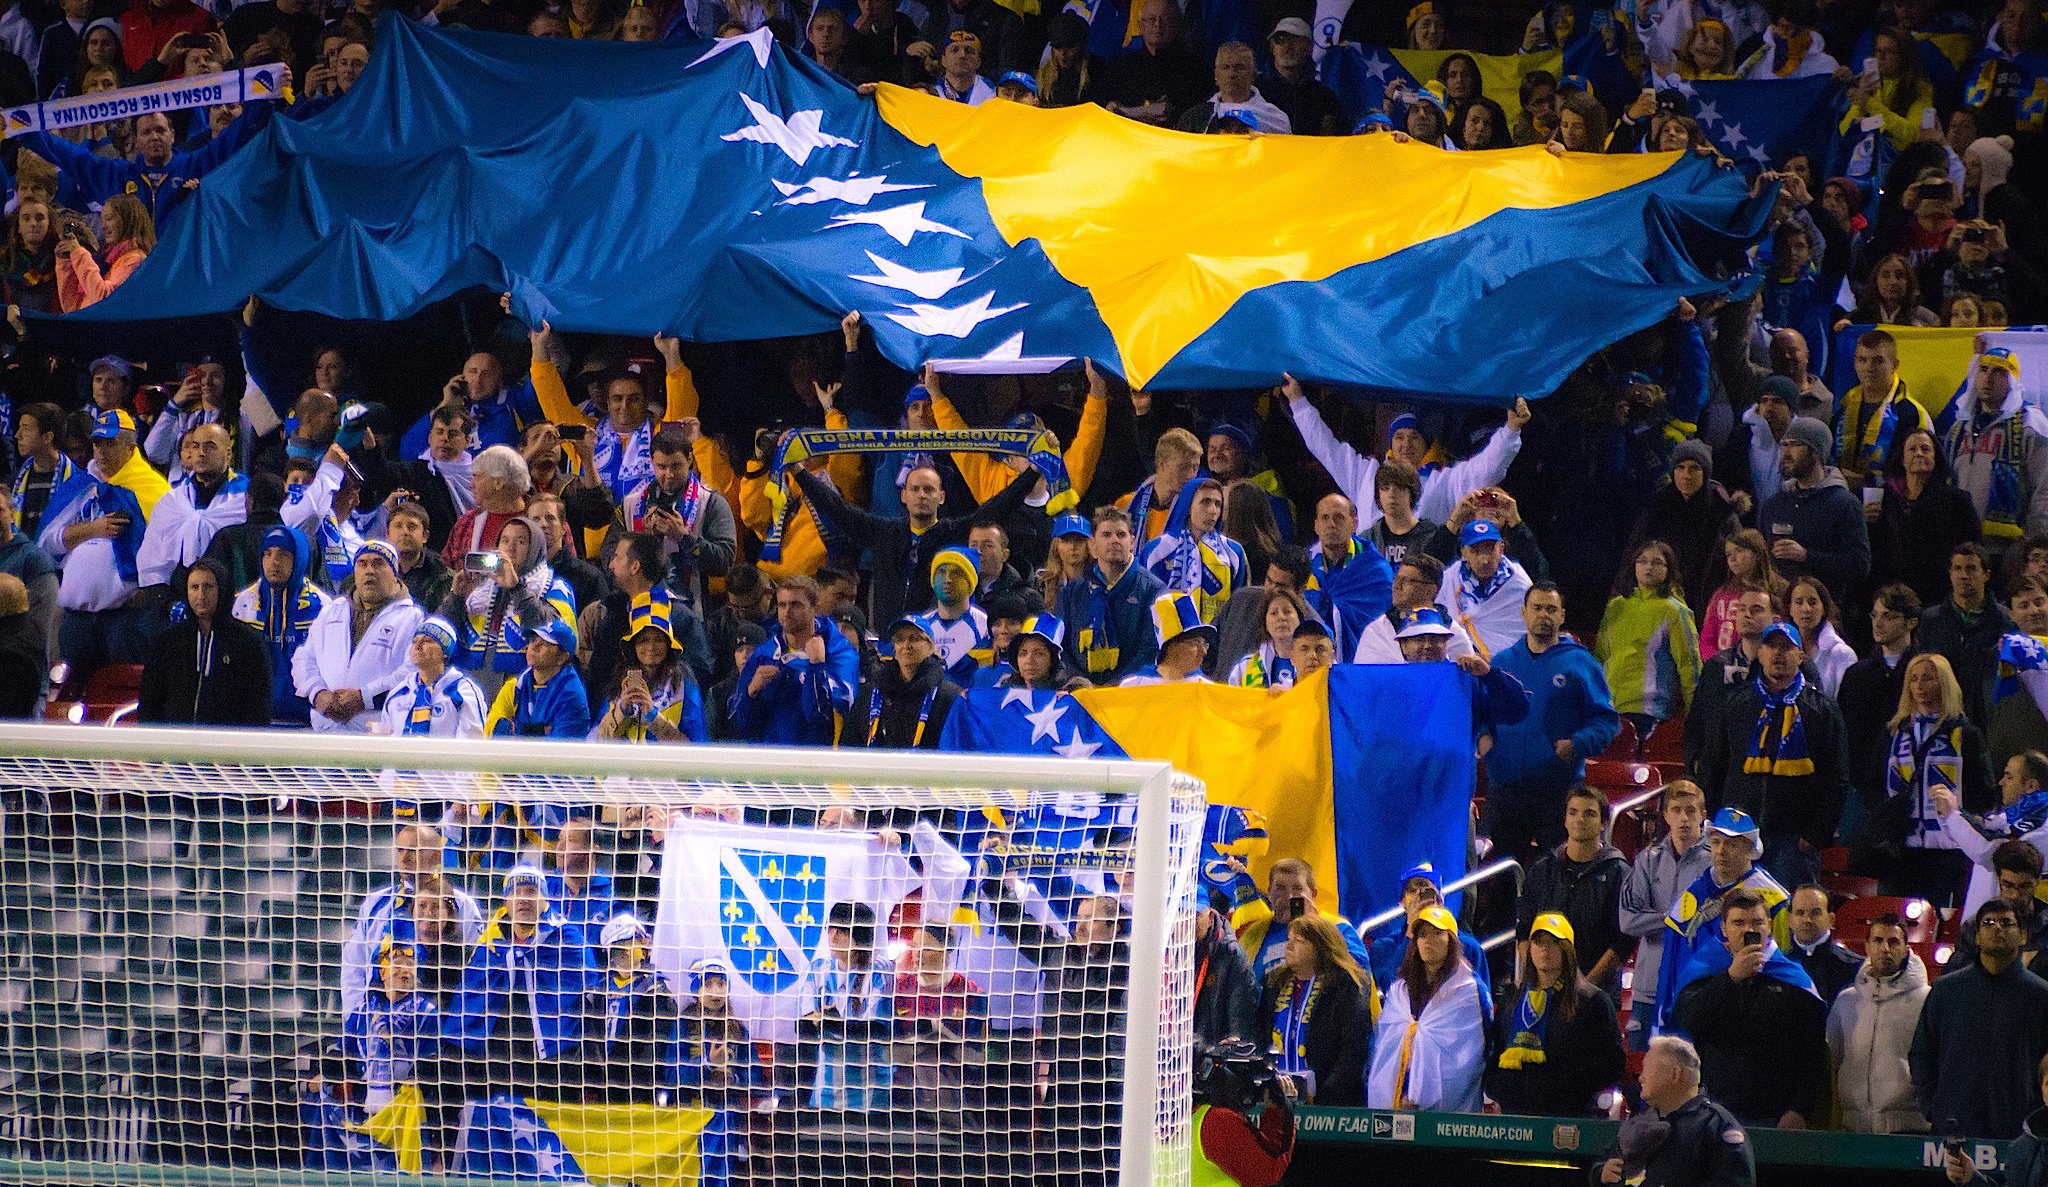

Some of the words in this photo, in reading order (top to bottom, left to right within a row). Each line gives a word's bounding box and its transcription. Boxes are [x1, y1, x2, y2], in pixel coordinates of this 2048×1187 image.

[172, 85, 222, 104] BOSNA
[810, 432, 876, 443] BOSNA
[1304, 1115, 1335, 1132] OWN
[1437, 1123, 1533, 1141] NEWERACAP.COM
